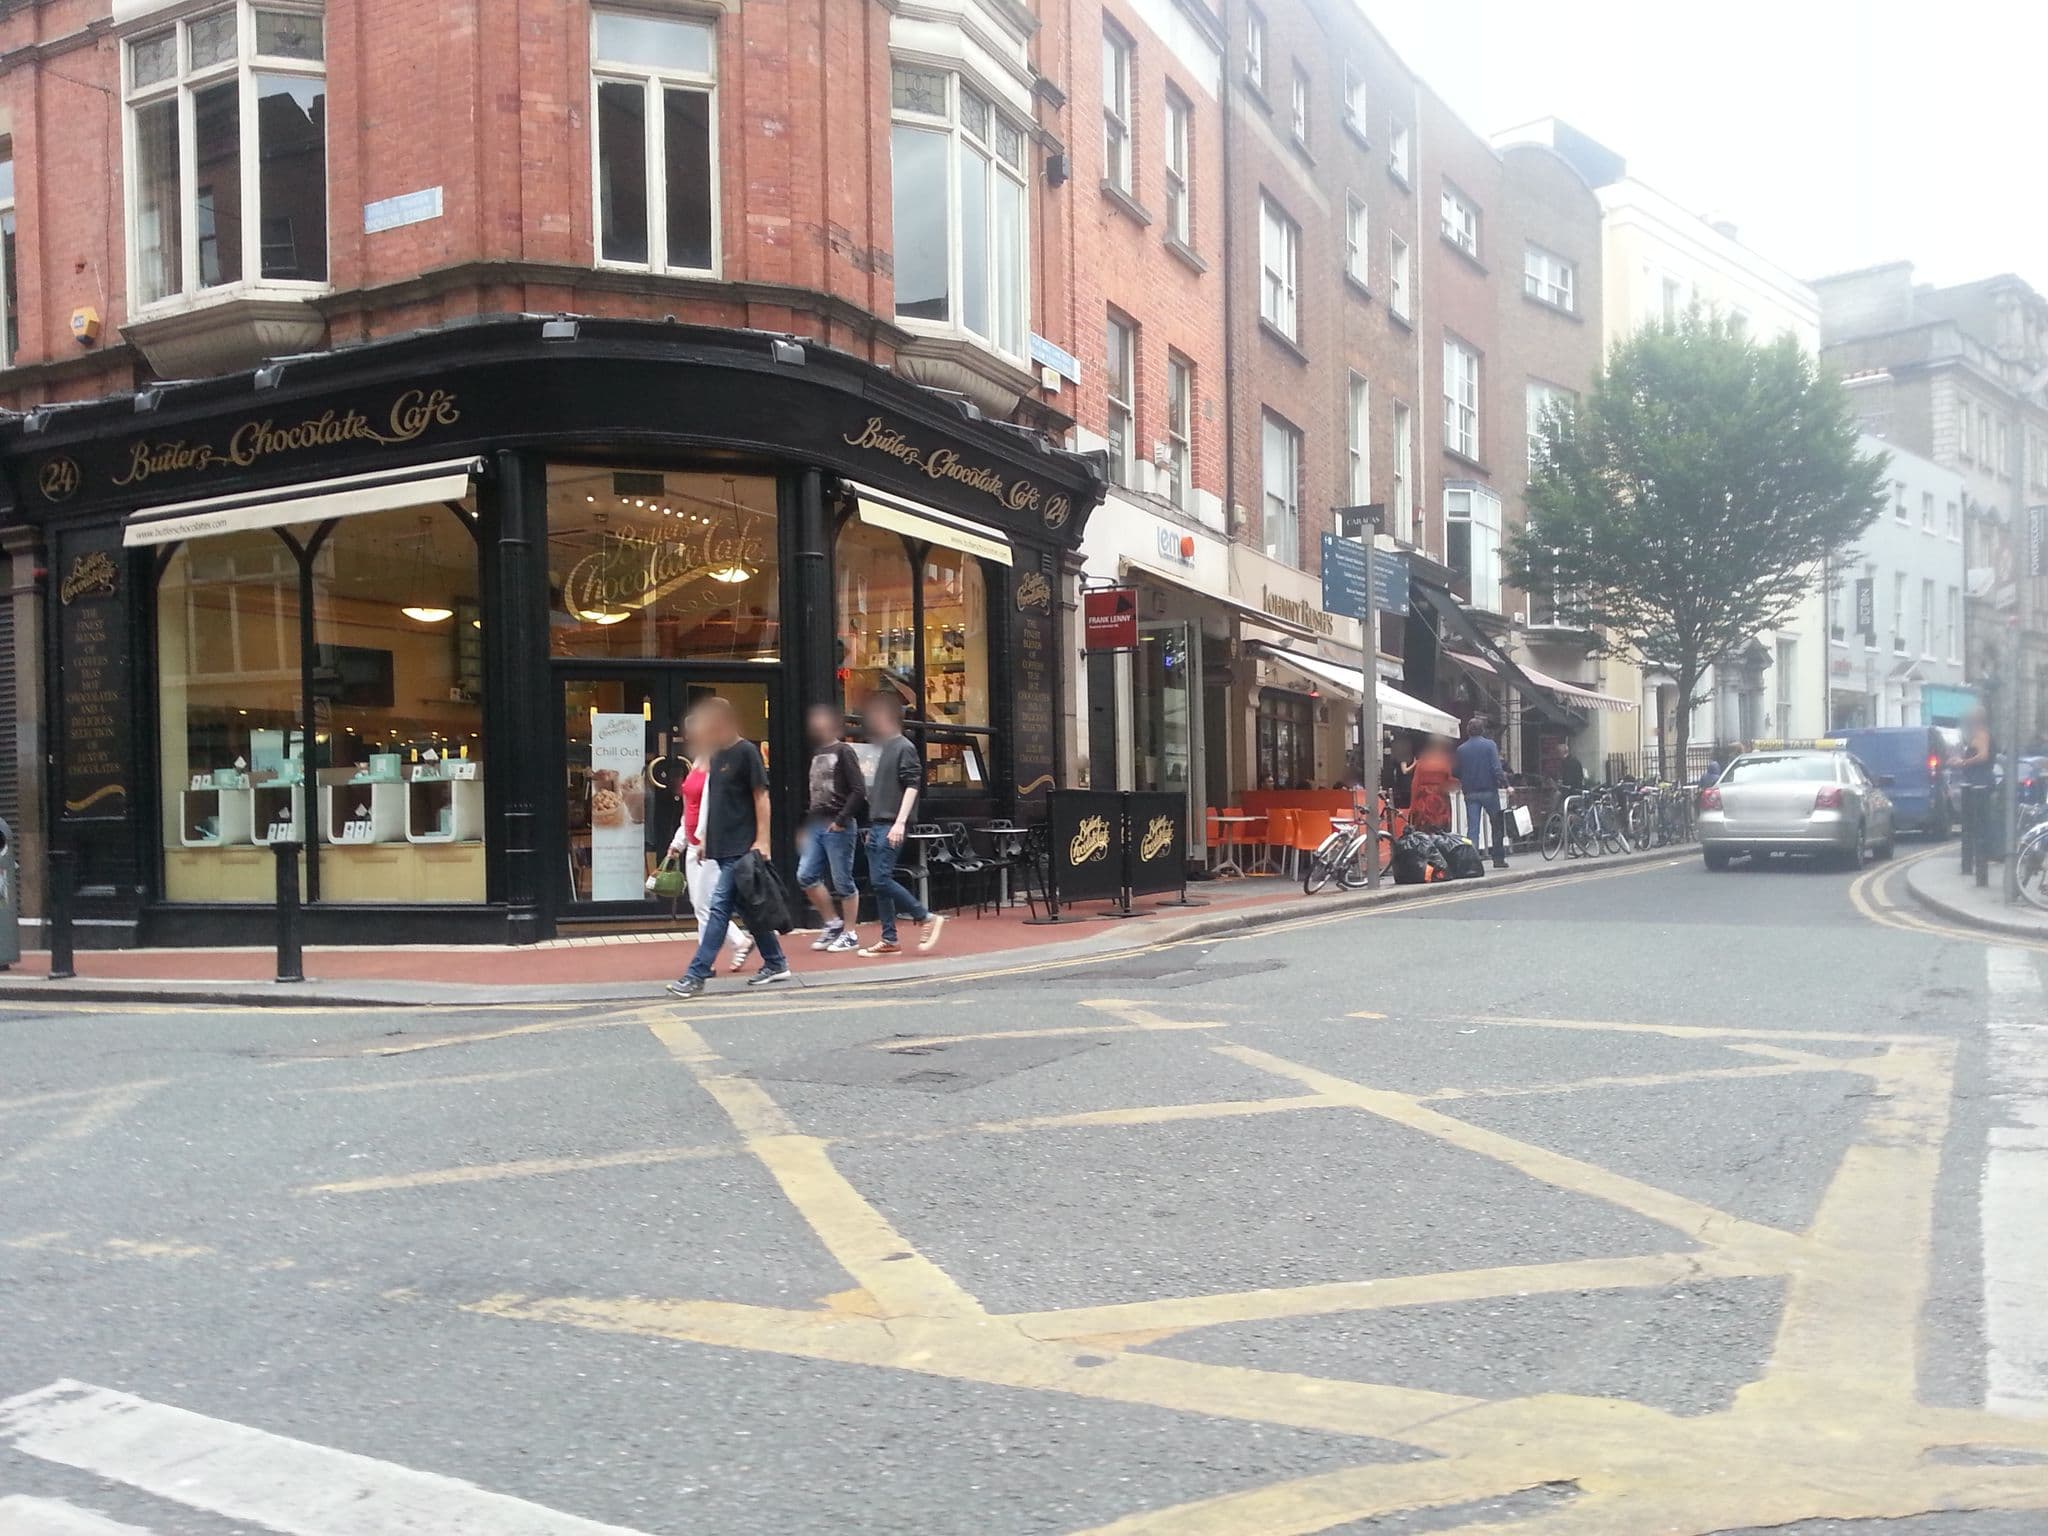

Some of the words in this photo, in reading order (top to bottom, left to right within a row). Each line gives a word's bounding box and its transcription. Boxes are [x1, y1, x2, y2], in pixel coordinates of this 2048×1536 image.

[113, 440, 216, 485] Butlers
[230, 409, 370, 467] Chocolate
[390, 389, 460, 442] Café
[46, 463, 72, 491] 24
[844, 417, 923, 466] Butlers
[927, 449, 1003, 500] Chocolate
[1005, 481, 1041, 511] Café
[1046, 497, 1067, 524] 24
[1089, 616, 1109, 624] FRANK
[1111, 615, 1131, 623] LENNY
[596, 747, 617, 756] Chill
[621, 747, 639, 756] Out
